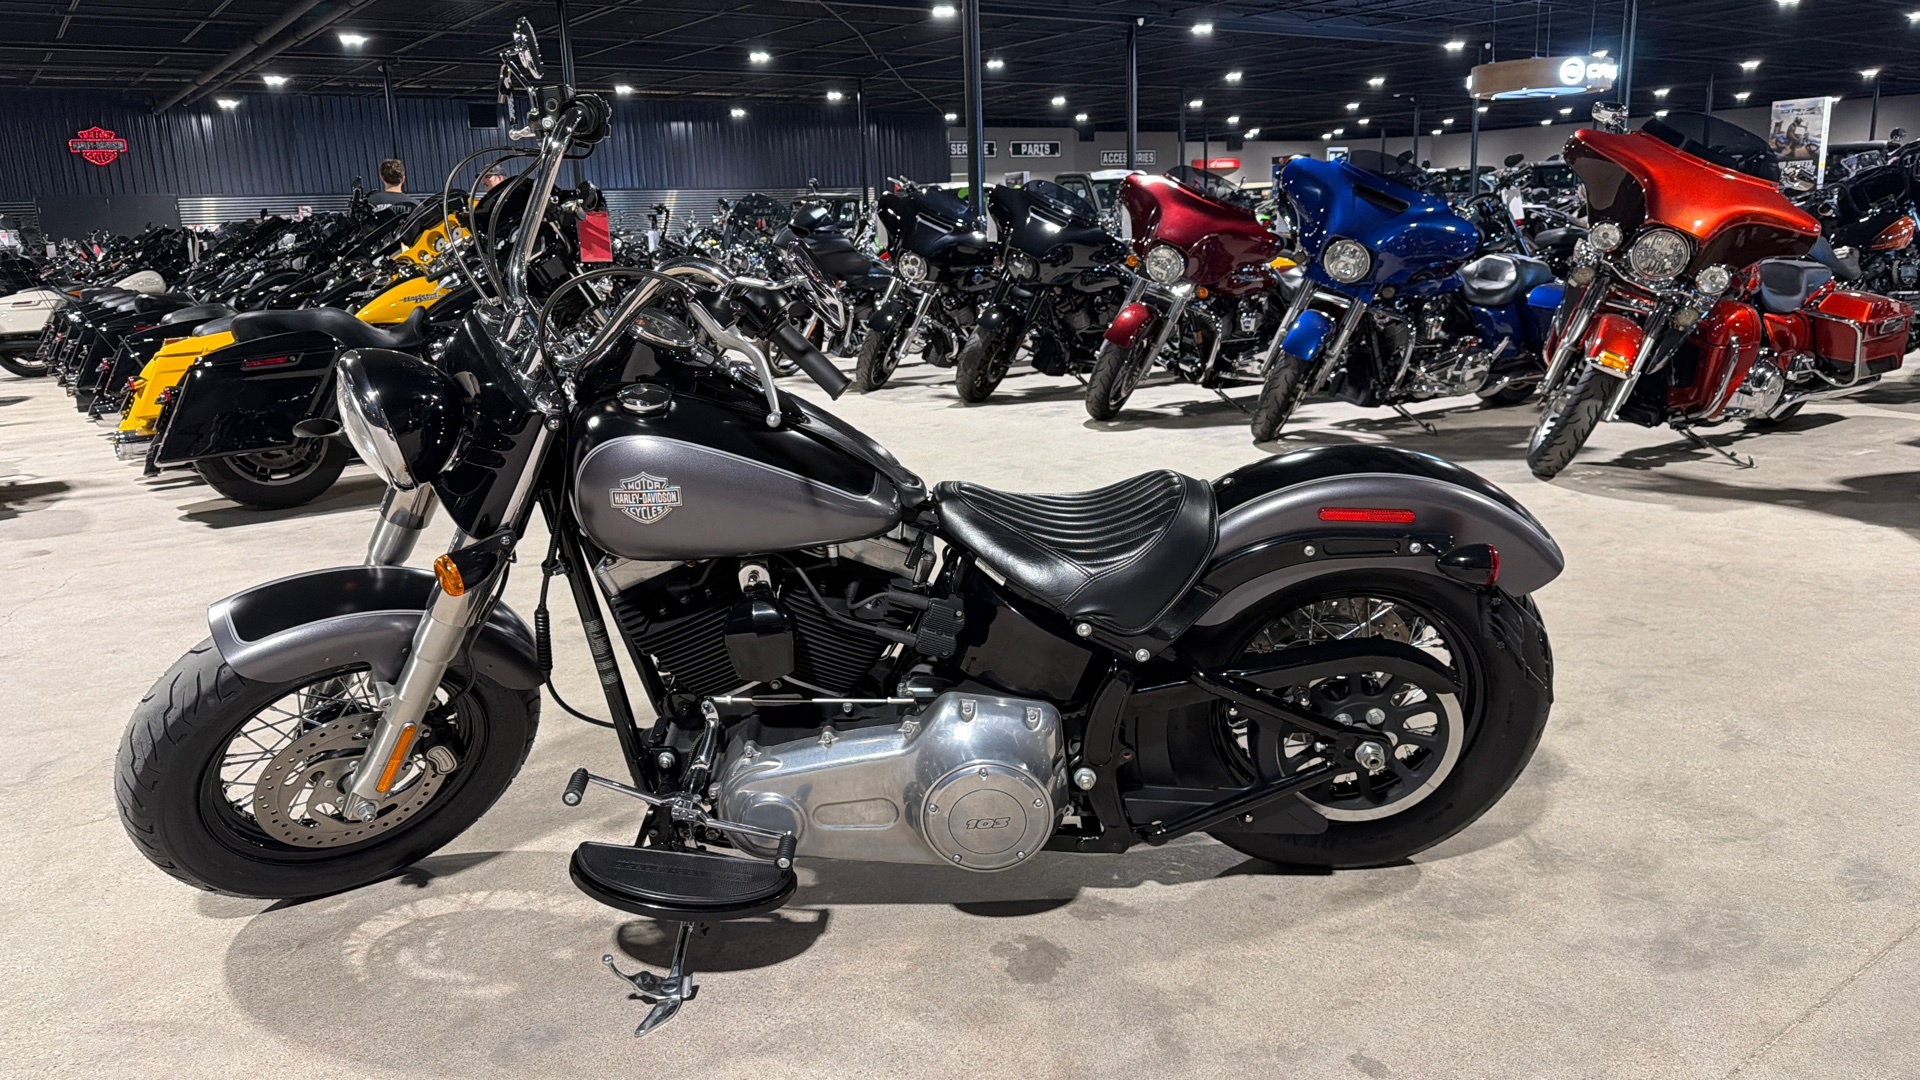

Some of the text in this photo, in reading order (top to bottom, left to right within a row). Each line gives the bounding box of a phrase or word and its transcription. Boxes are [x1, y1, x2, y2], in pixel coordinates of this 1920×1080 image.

[950, 143, 988, 154] SERE
[1021, 144, 1051, 155] PARTS
[1102, 152, 1154, 163] ACCESRIES
[627, 477, 661, 490] MOTOR
[614, 491, 677, 504] HARLEY-DAVIDSON
[629, 506, 663, 519] CYCLES
[965, 816, 1011, 830] 103
